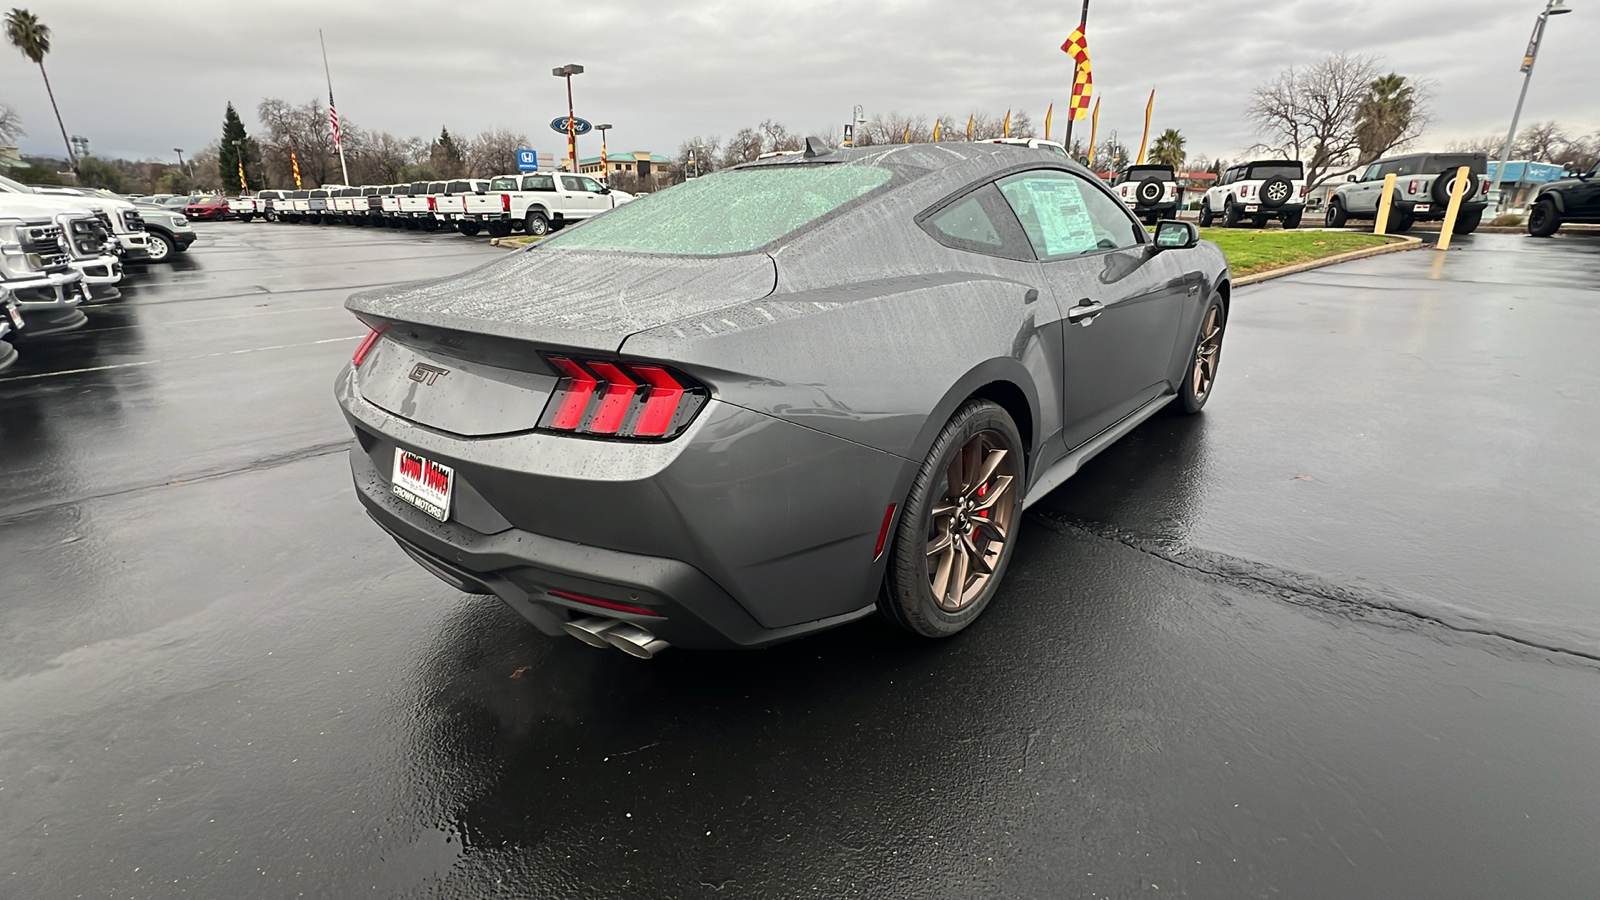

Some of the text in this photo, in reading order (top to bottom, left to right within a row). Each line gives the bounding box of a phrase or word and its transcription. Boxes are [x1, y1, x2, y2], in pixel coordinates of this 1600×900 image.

[409, 362, 450, 386] GT
[393, 485, 415, 504] CROWN
[415, 496, 442, 518] MOTORS
